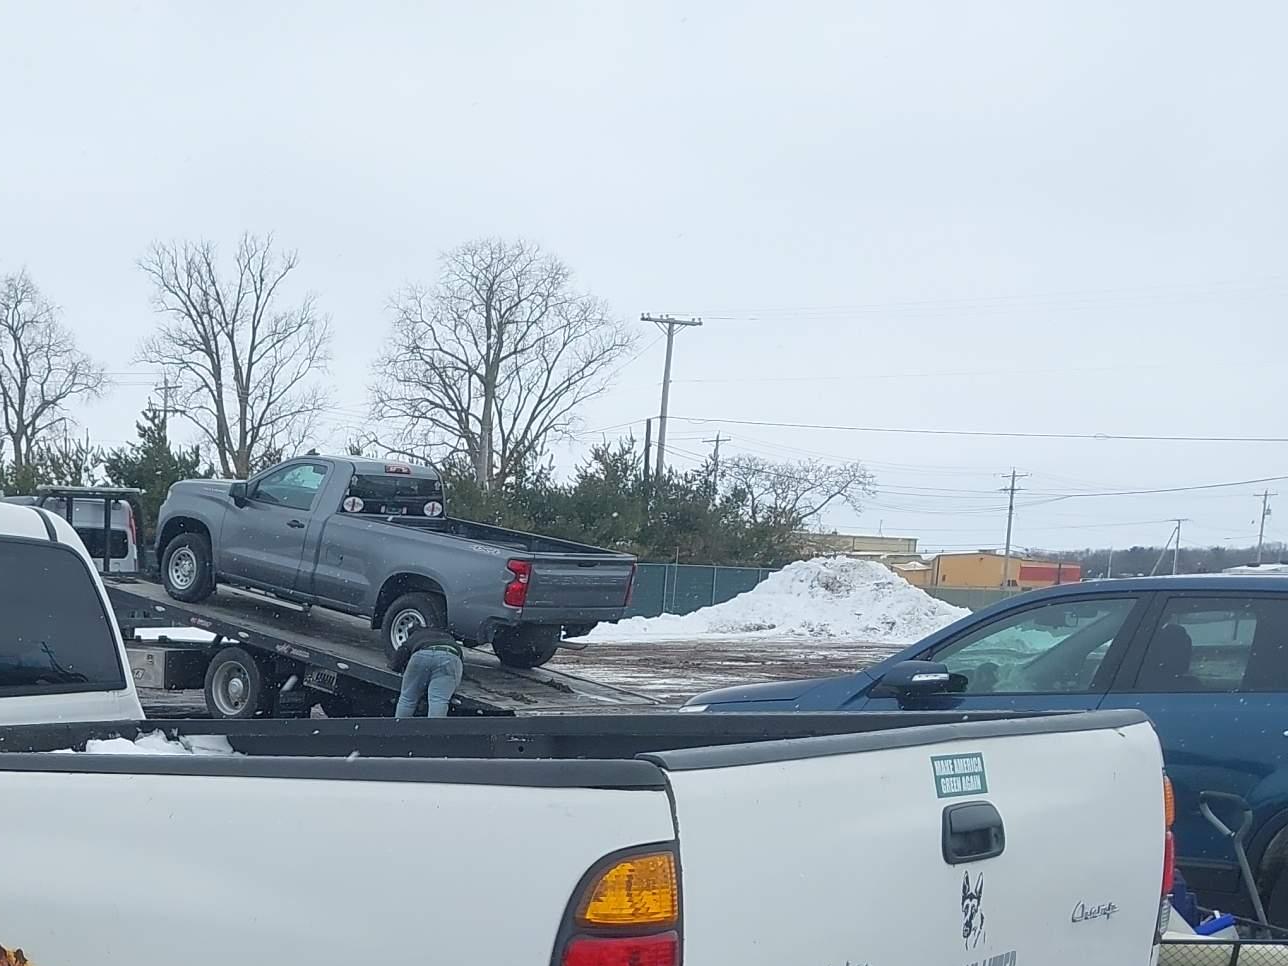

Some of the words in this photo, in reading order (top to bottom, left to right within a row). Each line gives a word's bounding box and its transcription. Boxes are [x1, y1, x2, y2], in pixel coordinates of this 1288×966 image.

[933, 759, 954, 776] MAKE
[953, 757, 983, 774] AMERICA
[940, 776, 962, 794] GREEN
[961, 775, 982, 792] AGAIN
